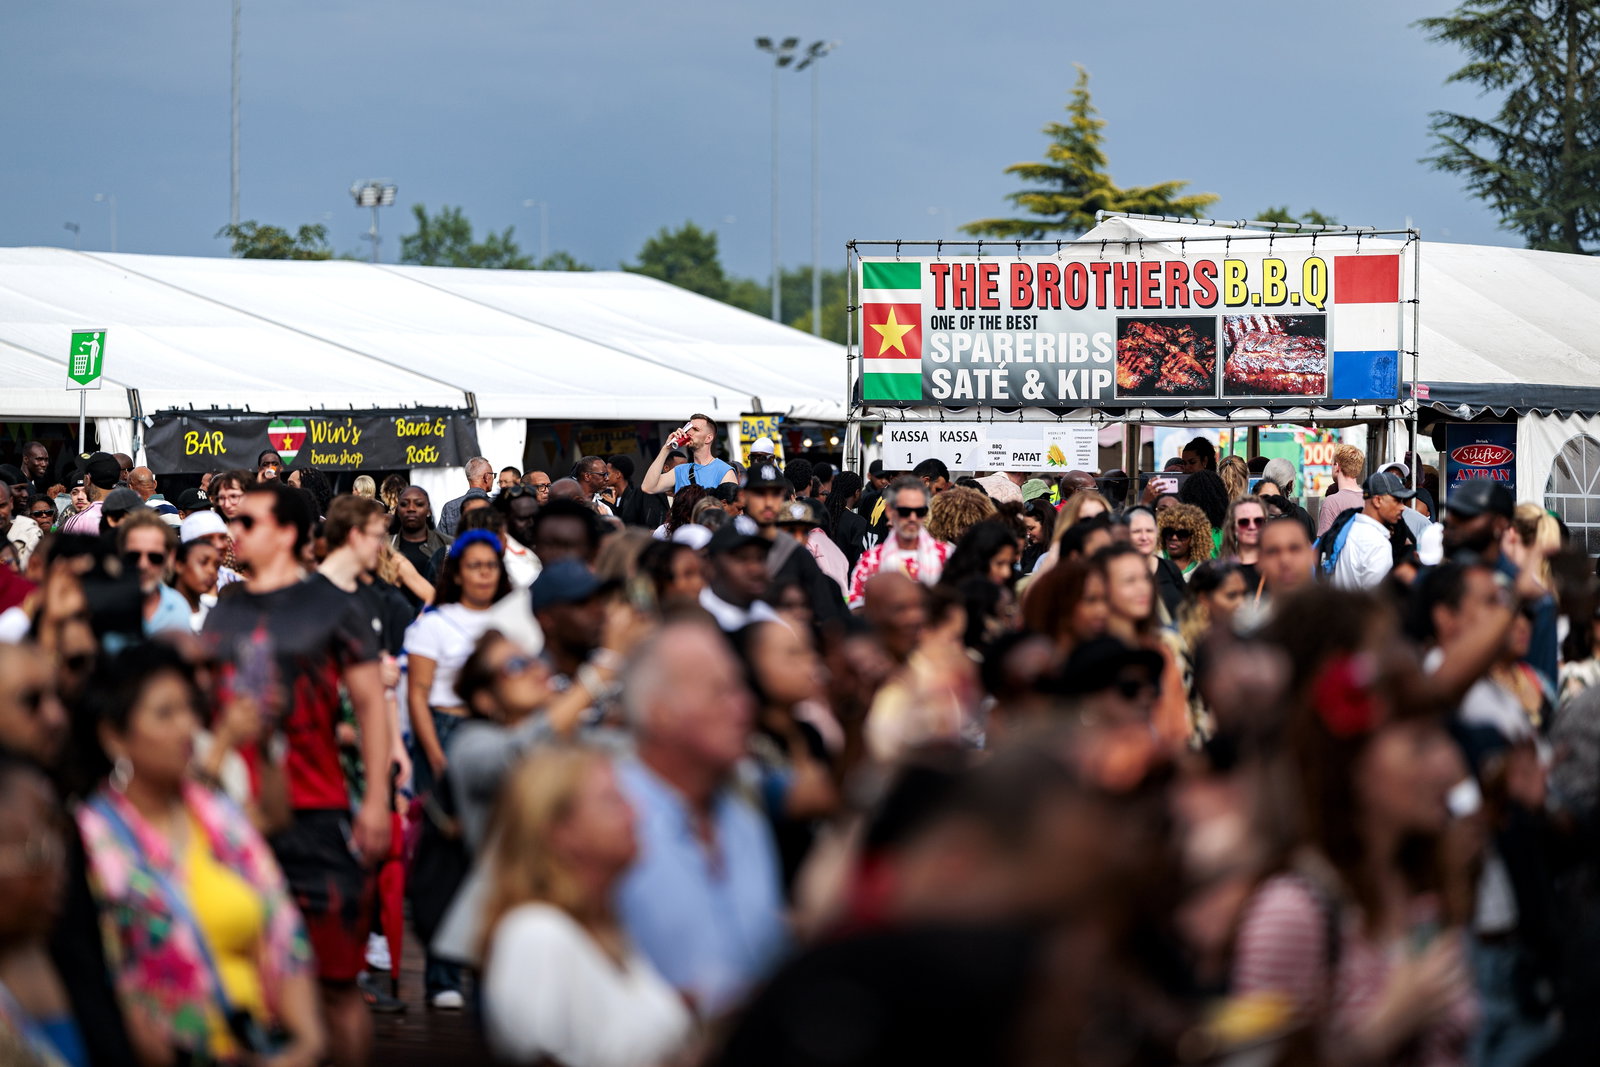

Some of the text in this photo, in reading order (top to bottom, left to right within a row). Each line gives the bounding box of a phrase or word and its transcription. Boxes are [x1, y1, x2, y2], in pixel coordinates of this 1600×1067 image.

[930, 257, 1328, 311] THE BROTHERS B.B.Q
[930, 315, 1038, 331] ONE OF THE BEST
[930, 332, 1113, 364] SPARERIBS
[931, 360, 1113, 400] SATÉ & KIP
[310, 418, 362, 446] Win's
[395, 417, 446, 438] Bara &
[742, 416, 779, 439] BARAS
[891, 431, 929, 442] KASSA
[940, 431, 978, 442] KASSA
[184, 430, 227, 456] BAR
[311, 449, 363, 468] bara shop
[406, 445, 439, 465] Roti
[906, 453, 913, 464] 1
[955, 453, 962, 464] 2
[1012, 452, 1042, 462] PATAT
[1455, 469, 1510, 481] AYRAN
